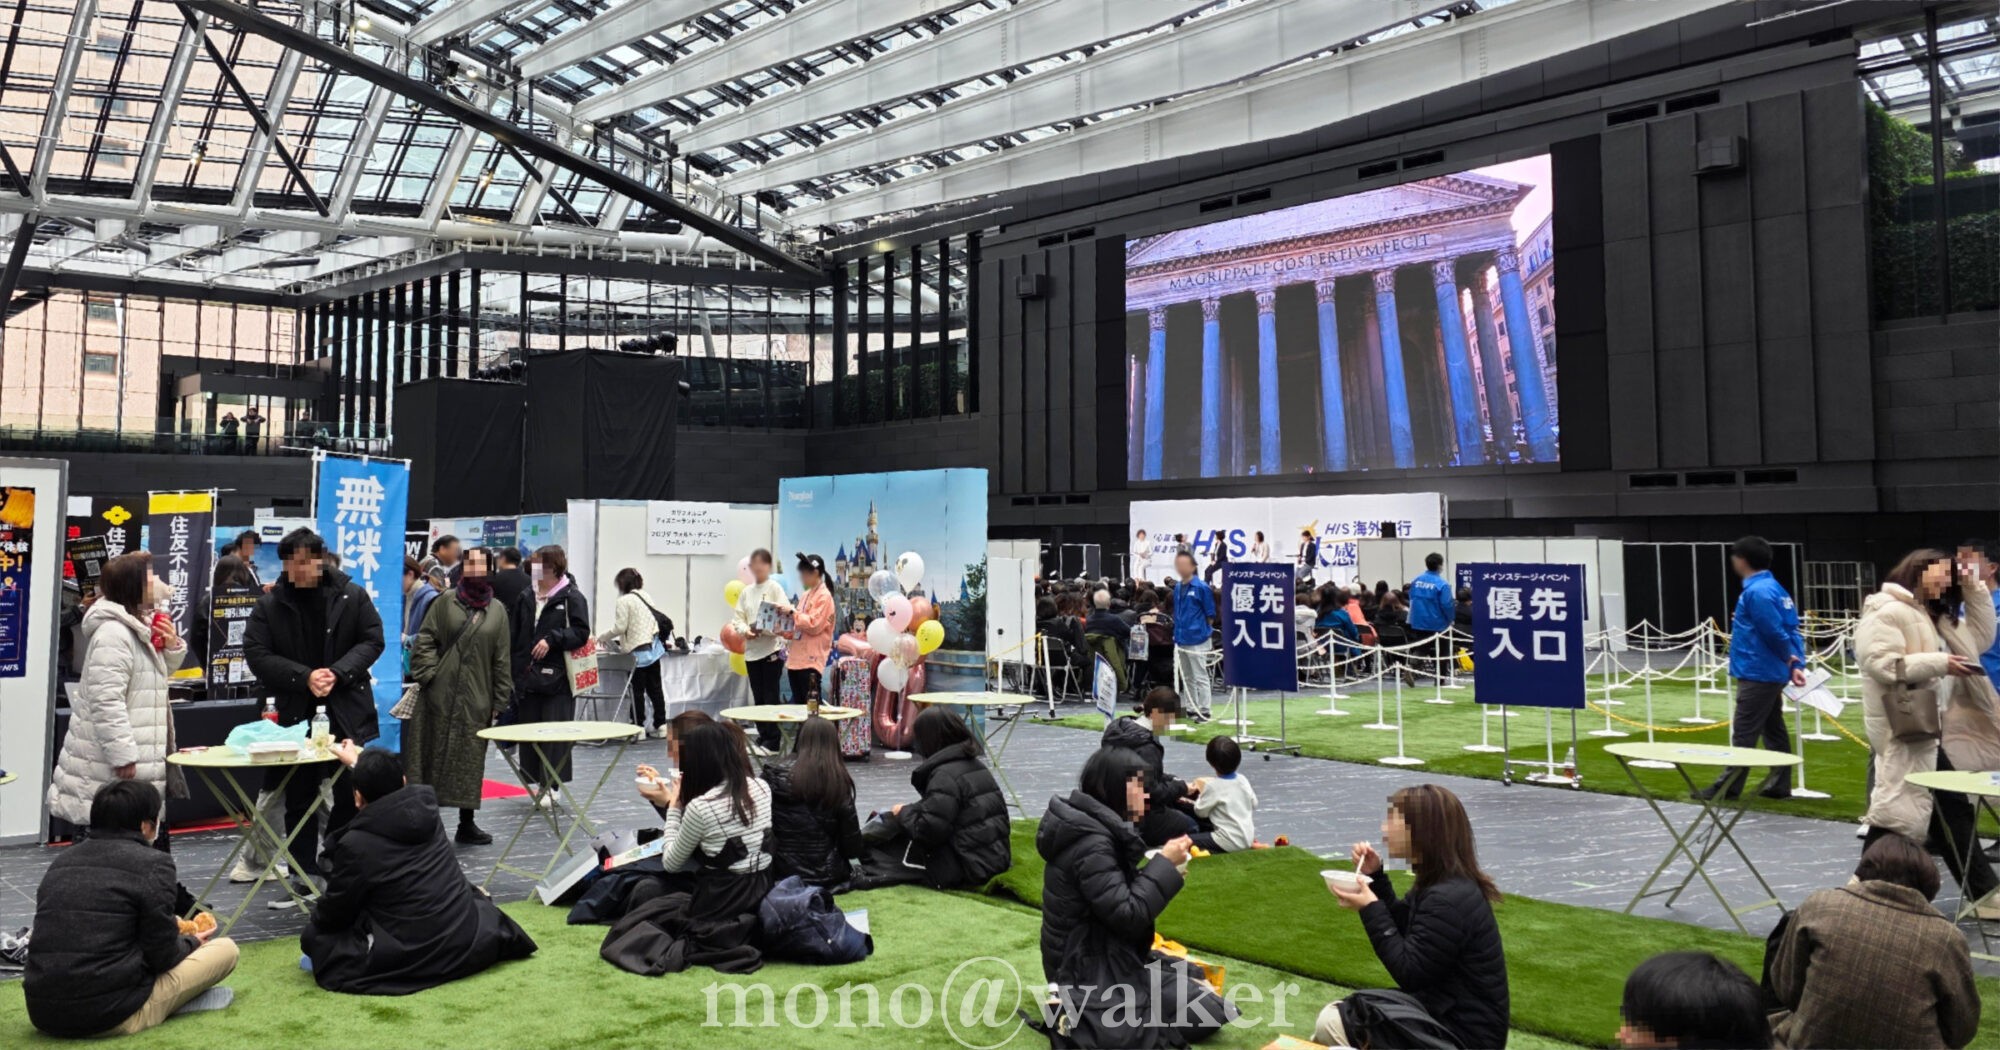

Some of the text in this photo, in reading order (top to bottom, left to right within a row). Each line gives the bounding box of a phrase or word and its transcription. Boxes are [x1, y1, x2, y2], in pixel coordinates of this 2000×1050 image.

[1192, 529, 1247, 558] HS
[1353, 520, 1412, 537] 海外行
[1228, 571, 1288, 579] メインステージイベント
[1482, 573, 1571, 582] メインステージイベント
[1231, 583, 1285, 615] 優先
[1486, 586, 1568, 622] 優先
[1232, 619, 1285, 650] 入口
[1488, 627, 1567, 662] 入口
